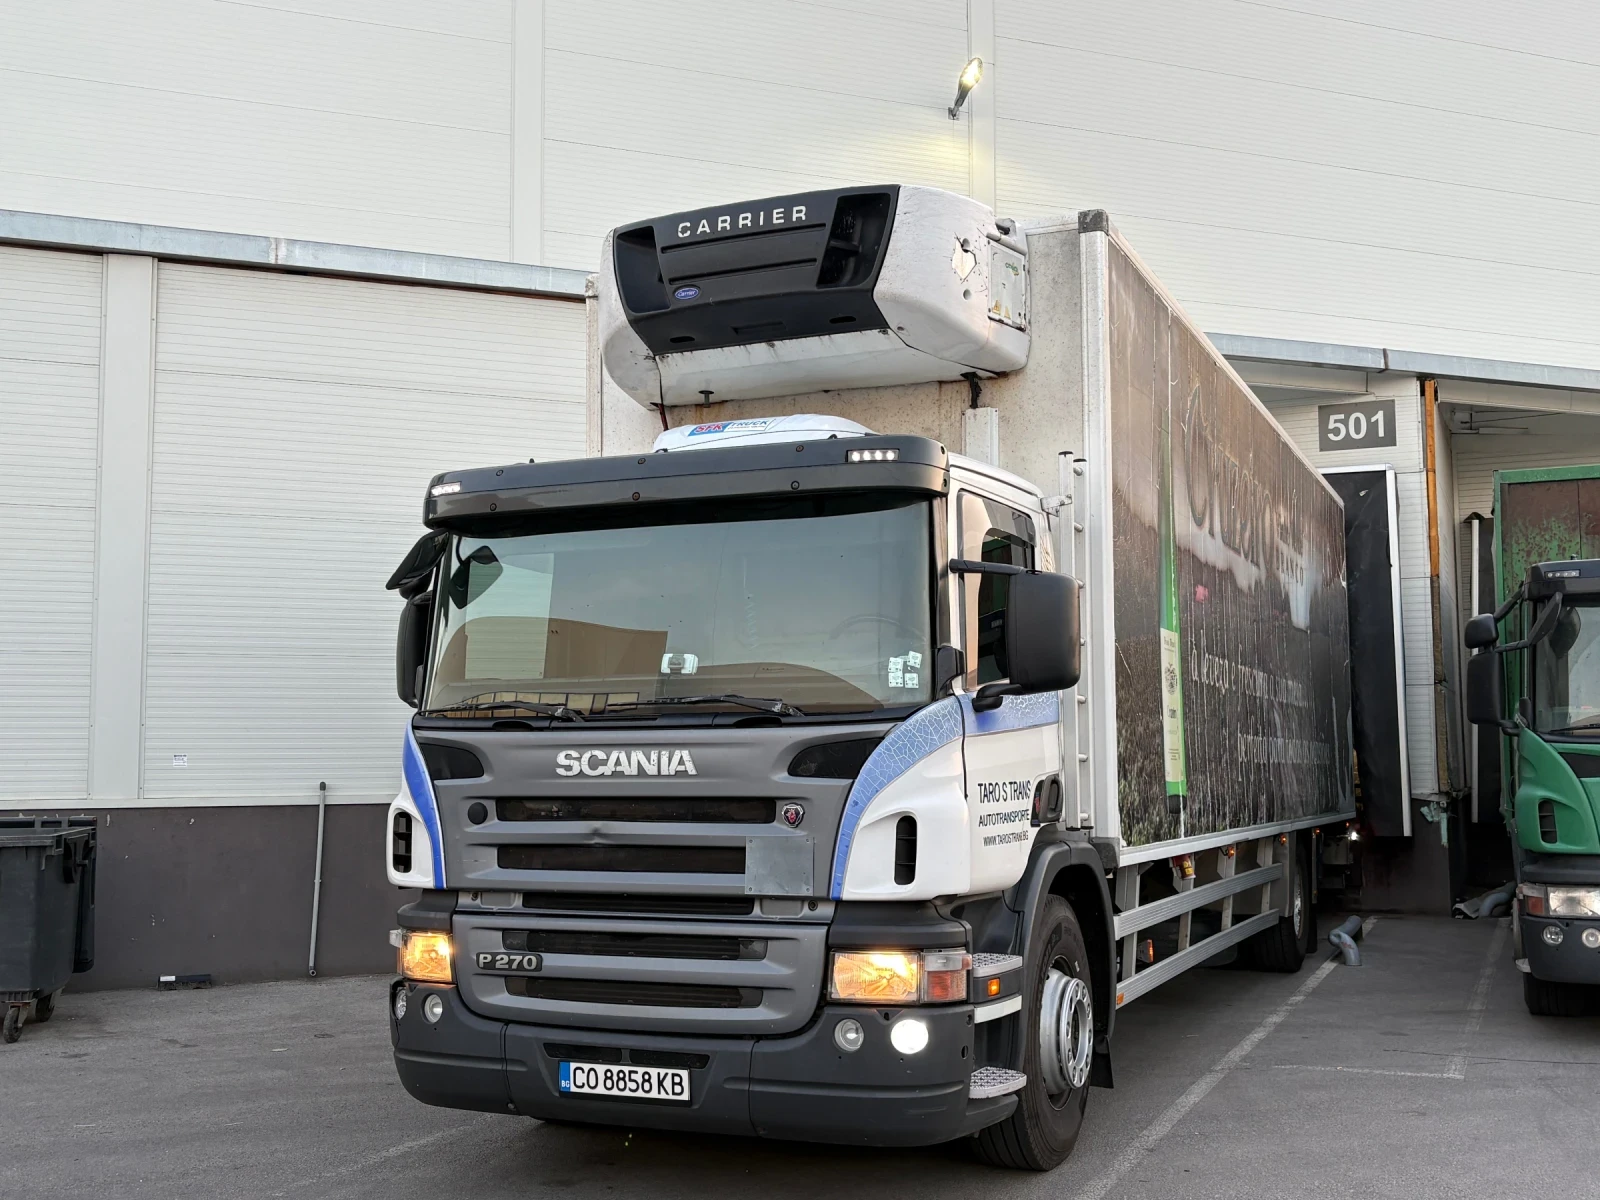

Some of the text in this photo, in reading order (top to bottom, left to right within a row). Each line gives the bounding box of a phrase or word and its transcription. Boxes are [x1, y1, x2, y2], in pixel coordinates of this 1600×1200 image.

[677, 205, 807, 238] CARRIER
[1327, 410, 1385, 441] 501
[555, 750, 698, 777] SCANIA
[977, 779, 1031, 804] TARO S TRANS
[479, 953, 537, 970] P 270
[561, 1080, 570, 1088] BG
[603, 1068, 653, 1094] 8858
[657, 1071, 685, 1096] KB
